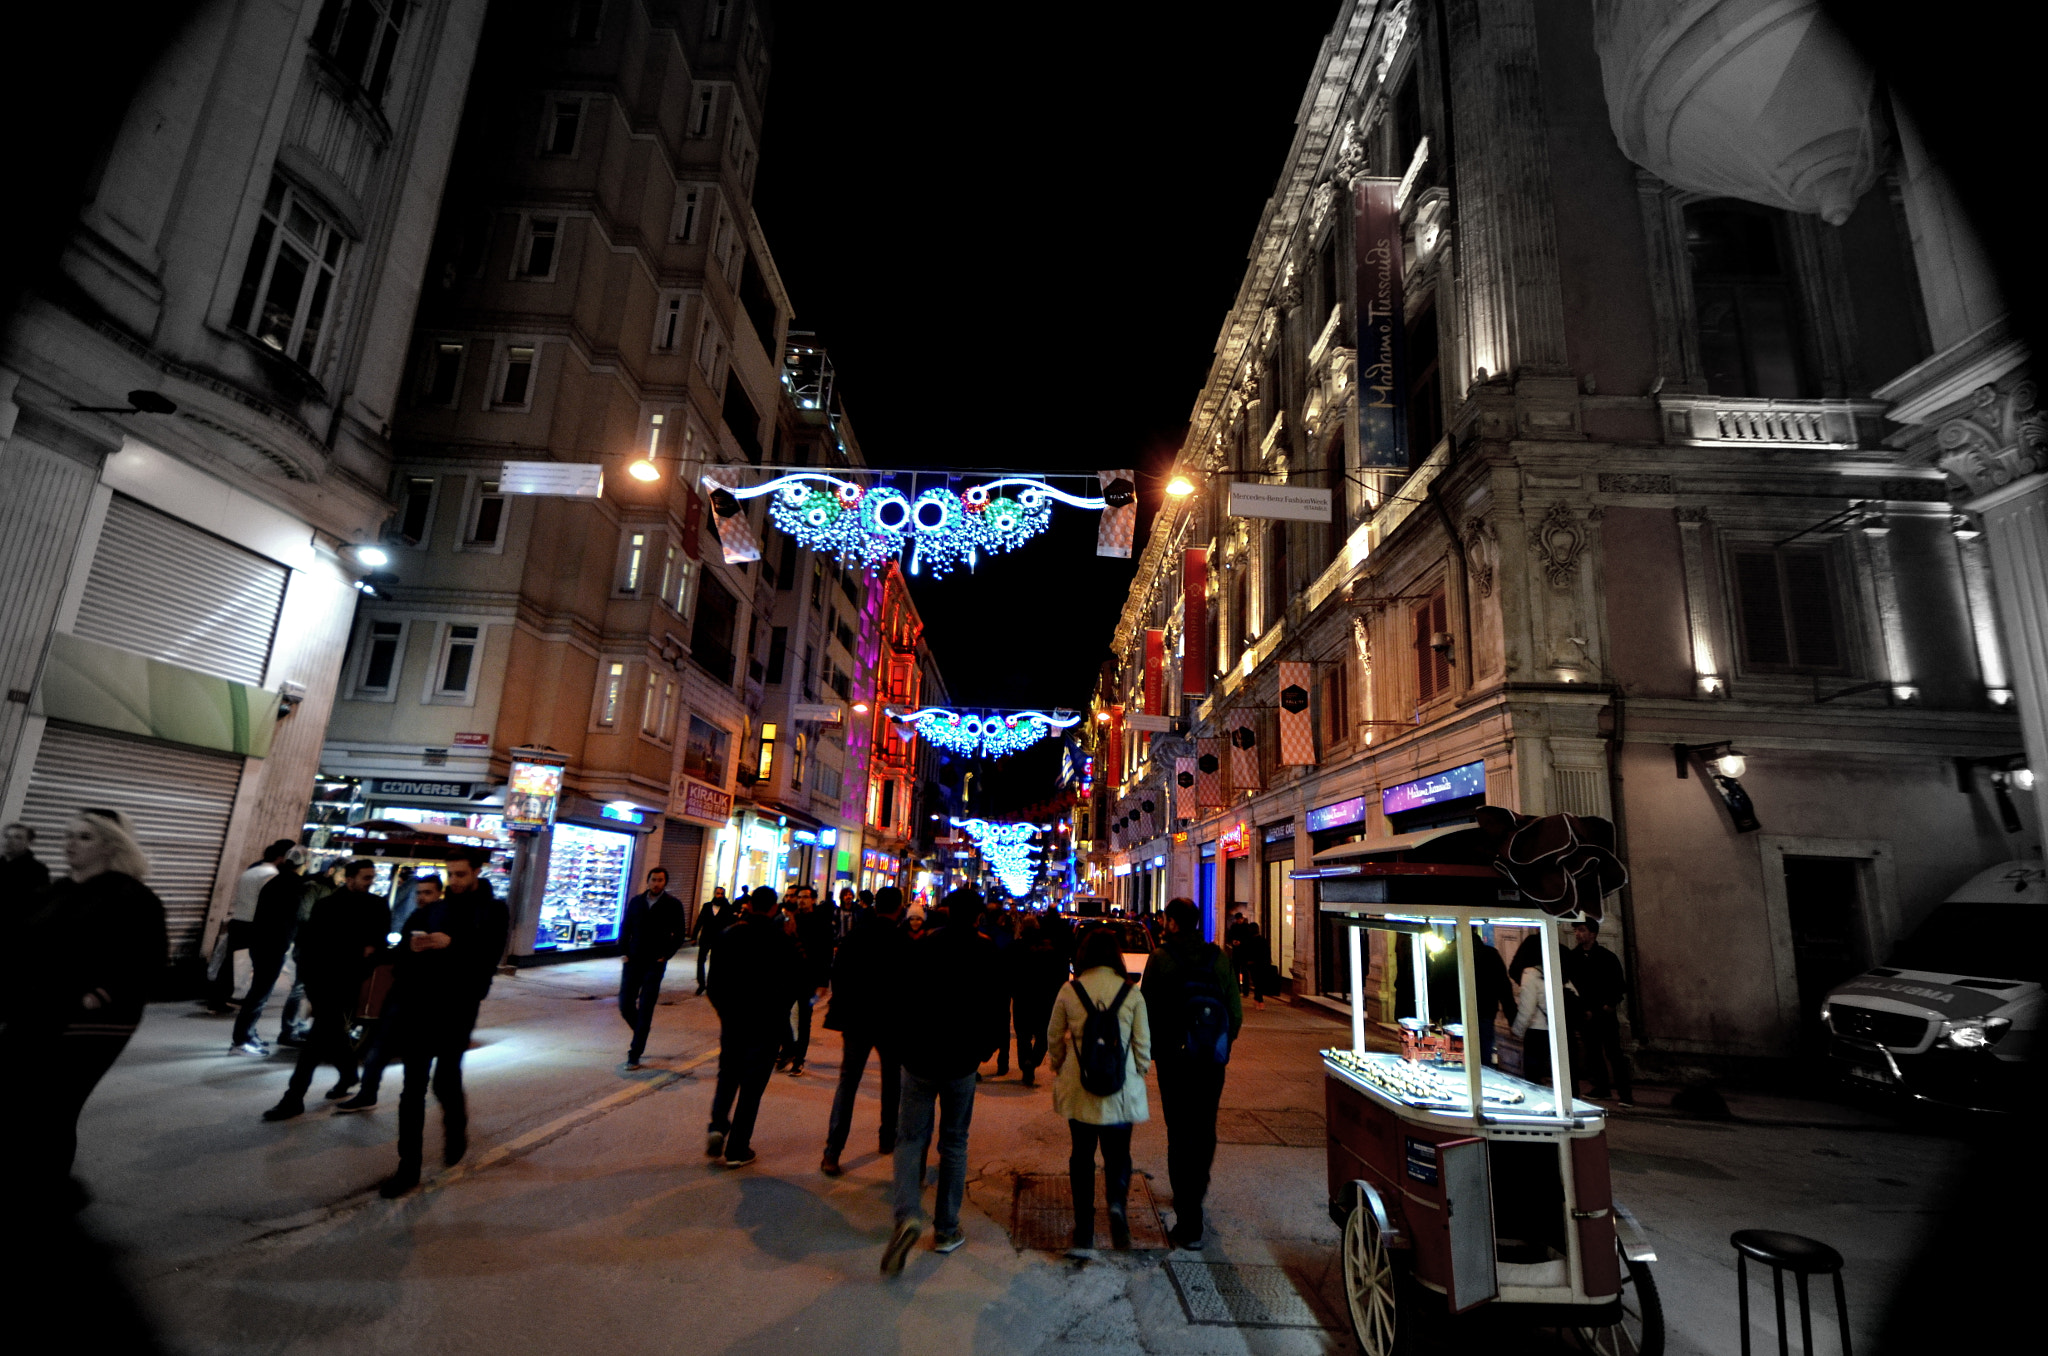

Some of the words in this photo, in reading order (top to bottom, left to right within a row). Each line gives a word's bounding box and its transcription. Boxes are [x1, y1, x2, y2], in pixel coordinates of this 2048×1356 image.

[1365, 238, 1392, 326] Tussauds
[1365, 319, 1396, 408] Madame
[381, 781, 461, 796] CONVERSE
